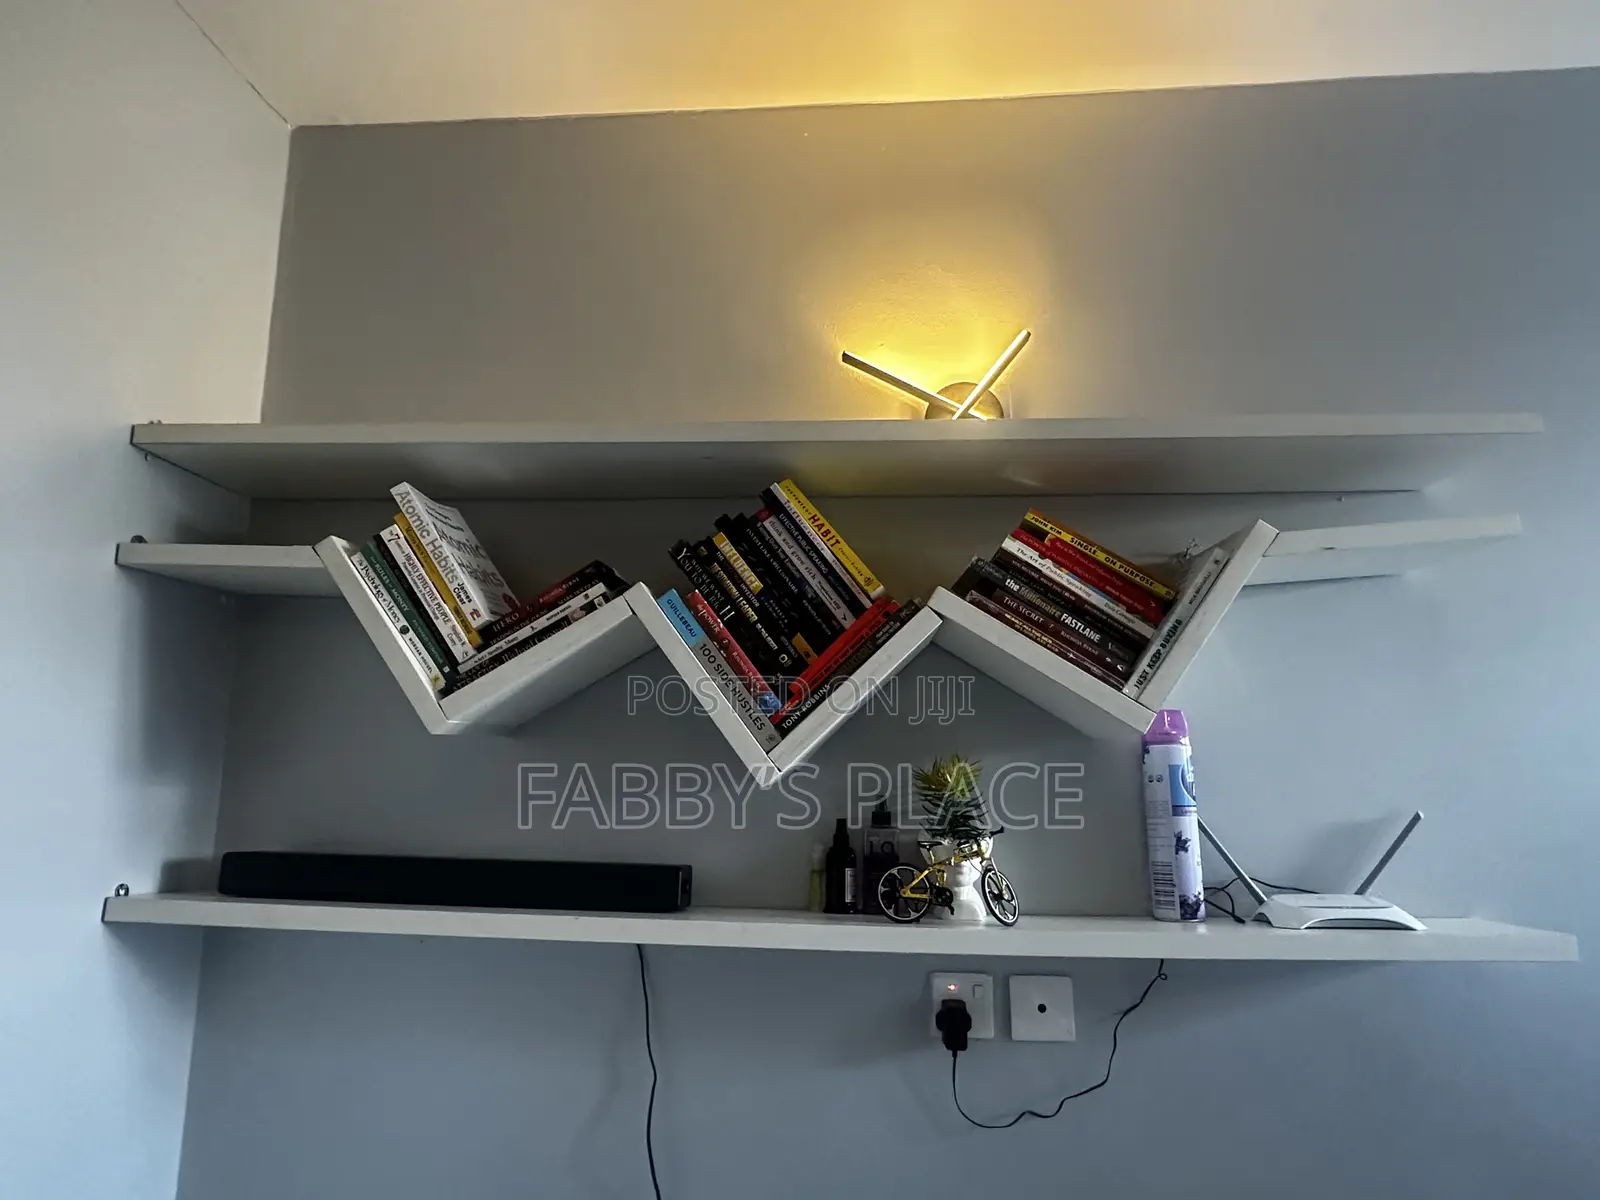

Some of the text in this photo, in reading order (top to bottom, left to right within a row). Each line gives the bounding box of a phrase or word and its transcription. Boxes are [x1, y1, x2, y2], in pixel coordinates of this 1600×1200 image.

[394, 486, 435, 541] Atomic
[425, 536, 462, 585] Habits
[432, 520, 490, 560] Atomic
[767, 519, 818, 581] think and grow rich
[777, 512, 800, 538] EFFECTIVE
[795, 534, 812, 553] PUBLIC
[807, 549, 830, 575] SPEAKING
[807, 512, 841, 550] HABIT
[1031, 514, 1050, 529] JOHN
[1049, 525, 1064, 537] KIM
[1103, 555, 1118, 568] ON
[373, 562, 392, 585] RULES
[389, 587, 411, 613] MONEY
[386, 532, 401, 545] 7
[402, 552, 420, 574] HIGHLY
[414, 572, 439, 604] EFFECTIVE
[432, 600, 453, 626] PEOPLE
[674, 546, 698, 572] YOU
[690, 571, 704, 585] TO
[718, 538, 761, 592] INFLUENCE
[1015, 547, 1093, 599] The Art of Public Speaking
[359, 564, 388, 600] Psychology
[383, 599, 404, 624] Money
[452, 586, 467, 606] Clear
[456, 580, 474, 604] James
[708, 582, 726, 603] WANT
[734, 595, 759, 624] LEADER
[739, 582, 761, 608] INVESTOR
[1001, 595, 1045, 627] THE SECRET
[1004, 577, 1021, 592] the
[1017, 586, 1064, 619] Millionaire
[1059, 612, 1103, 644] FASTLANE
[491, 611, 521, 633] HERO
[664, 597, 699, 639] GUILLEBEAU
[697, 608, 721, 636] POWER
[1132, 617, 1185, 690] JUST KEEP BUYING
[697, 642, 768, 733] 100 SIDE HUSTLES
[780, 708, 804, 731] TONY
[799, 682, 833, 713] ROBBINS
